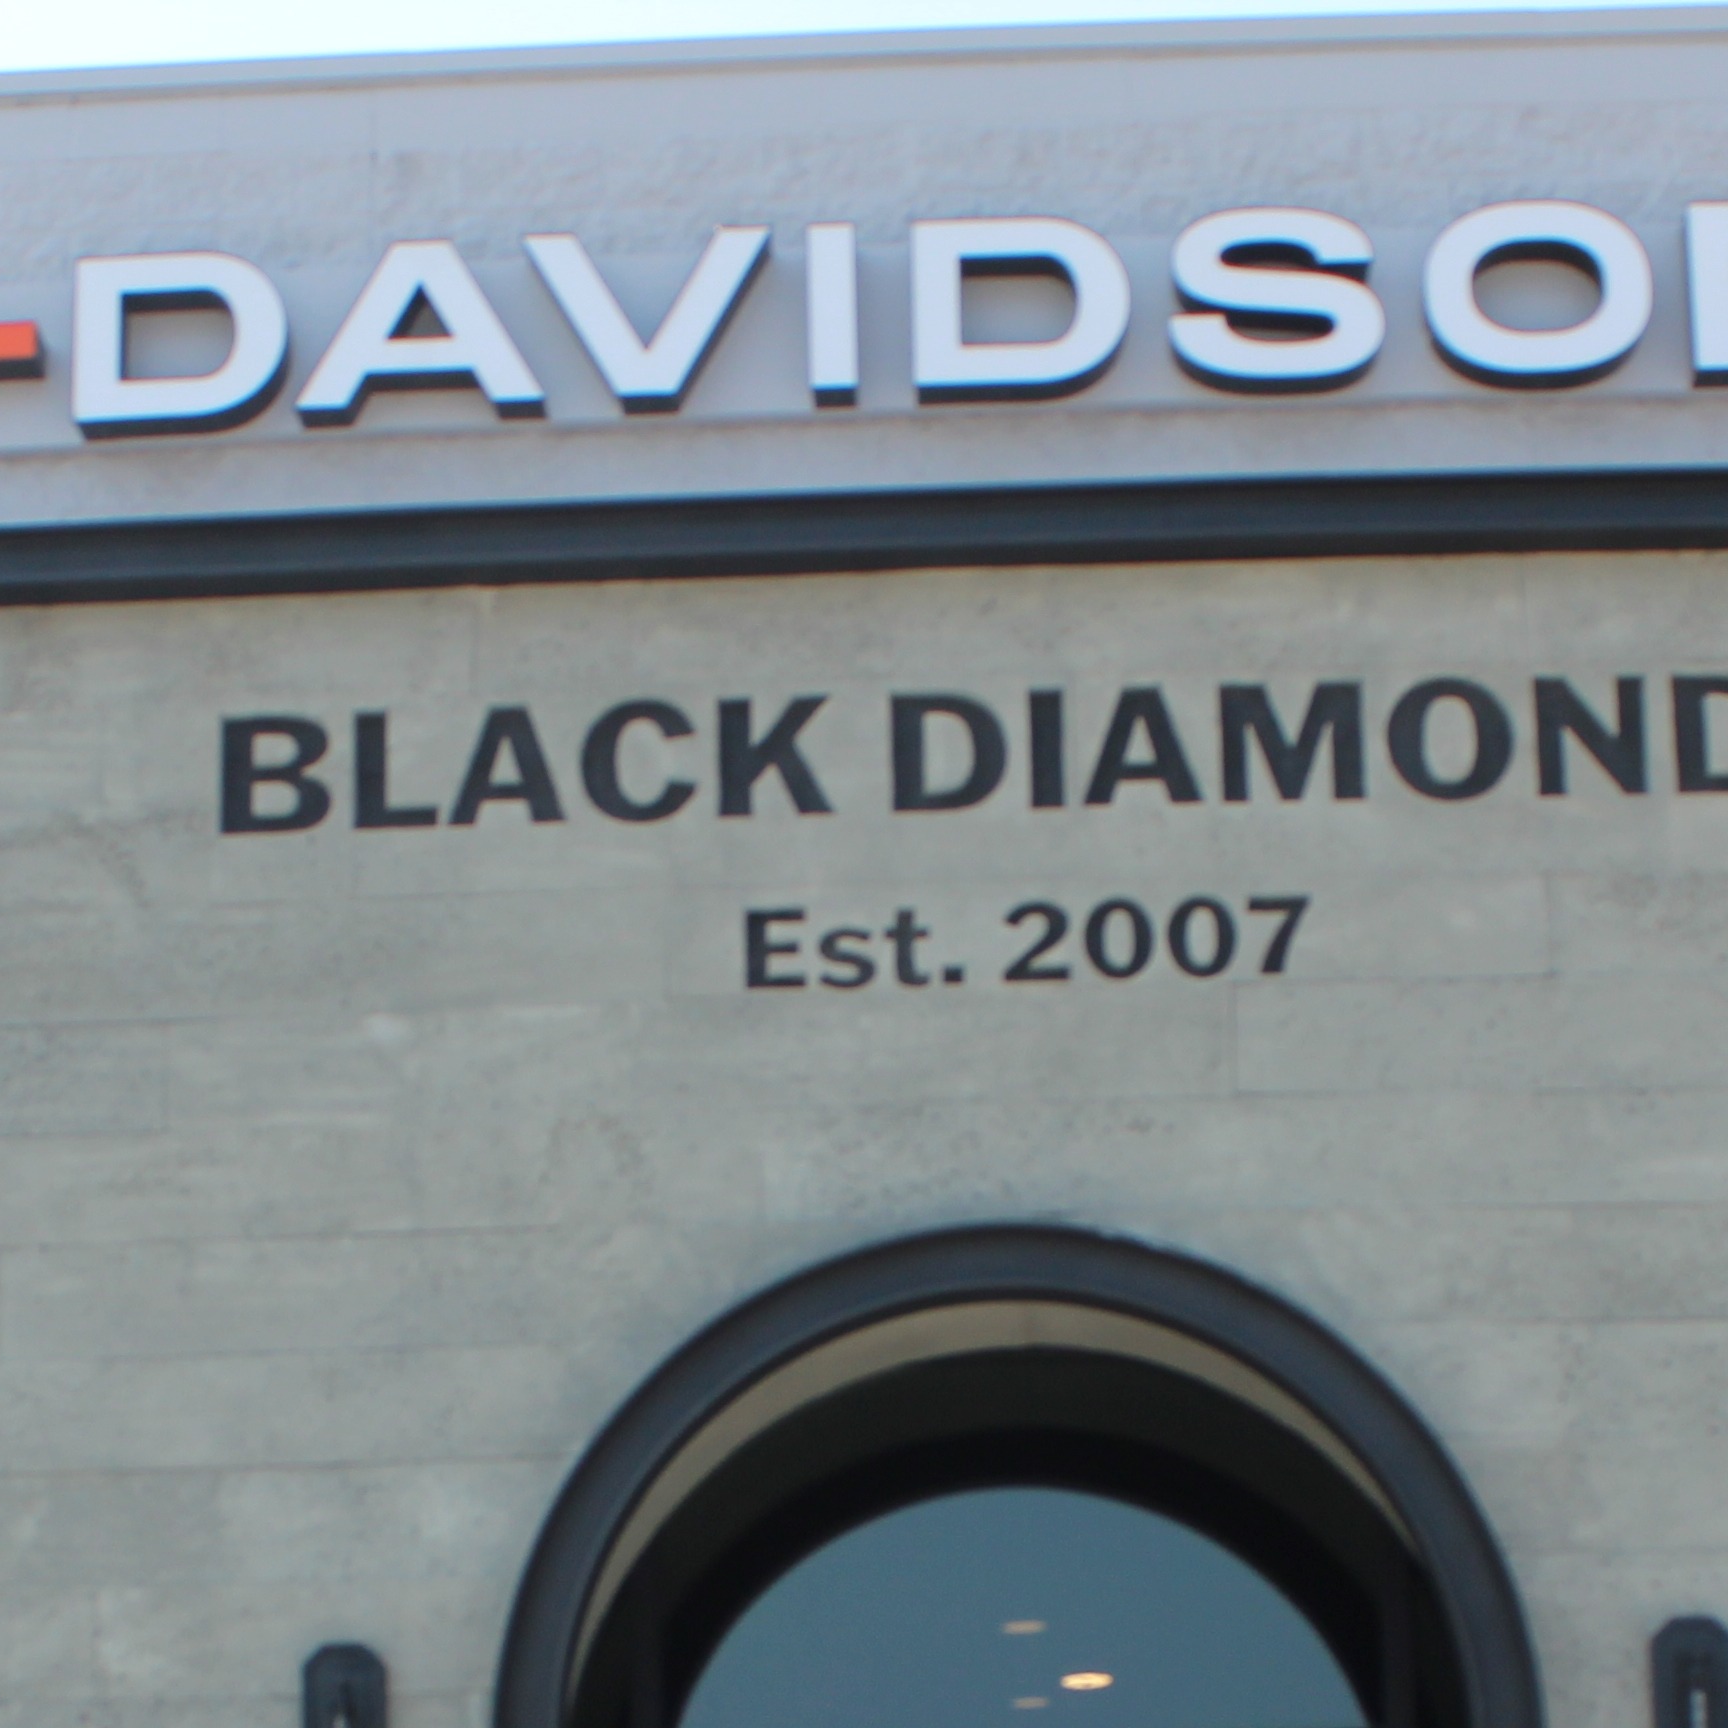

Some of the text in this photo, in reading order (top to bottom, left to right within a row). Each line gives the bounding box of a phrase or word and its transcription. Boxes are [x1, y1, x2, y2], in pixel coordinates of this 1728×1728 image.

[218, 692, 834, 834] BLACK
[744, 896, 1312, 990] Est. 2007
